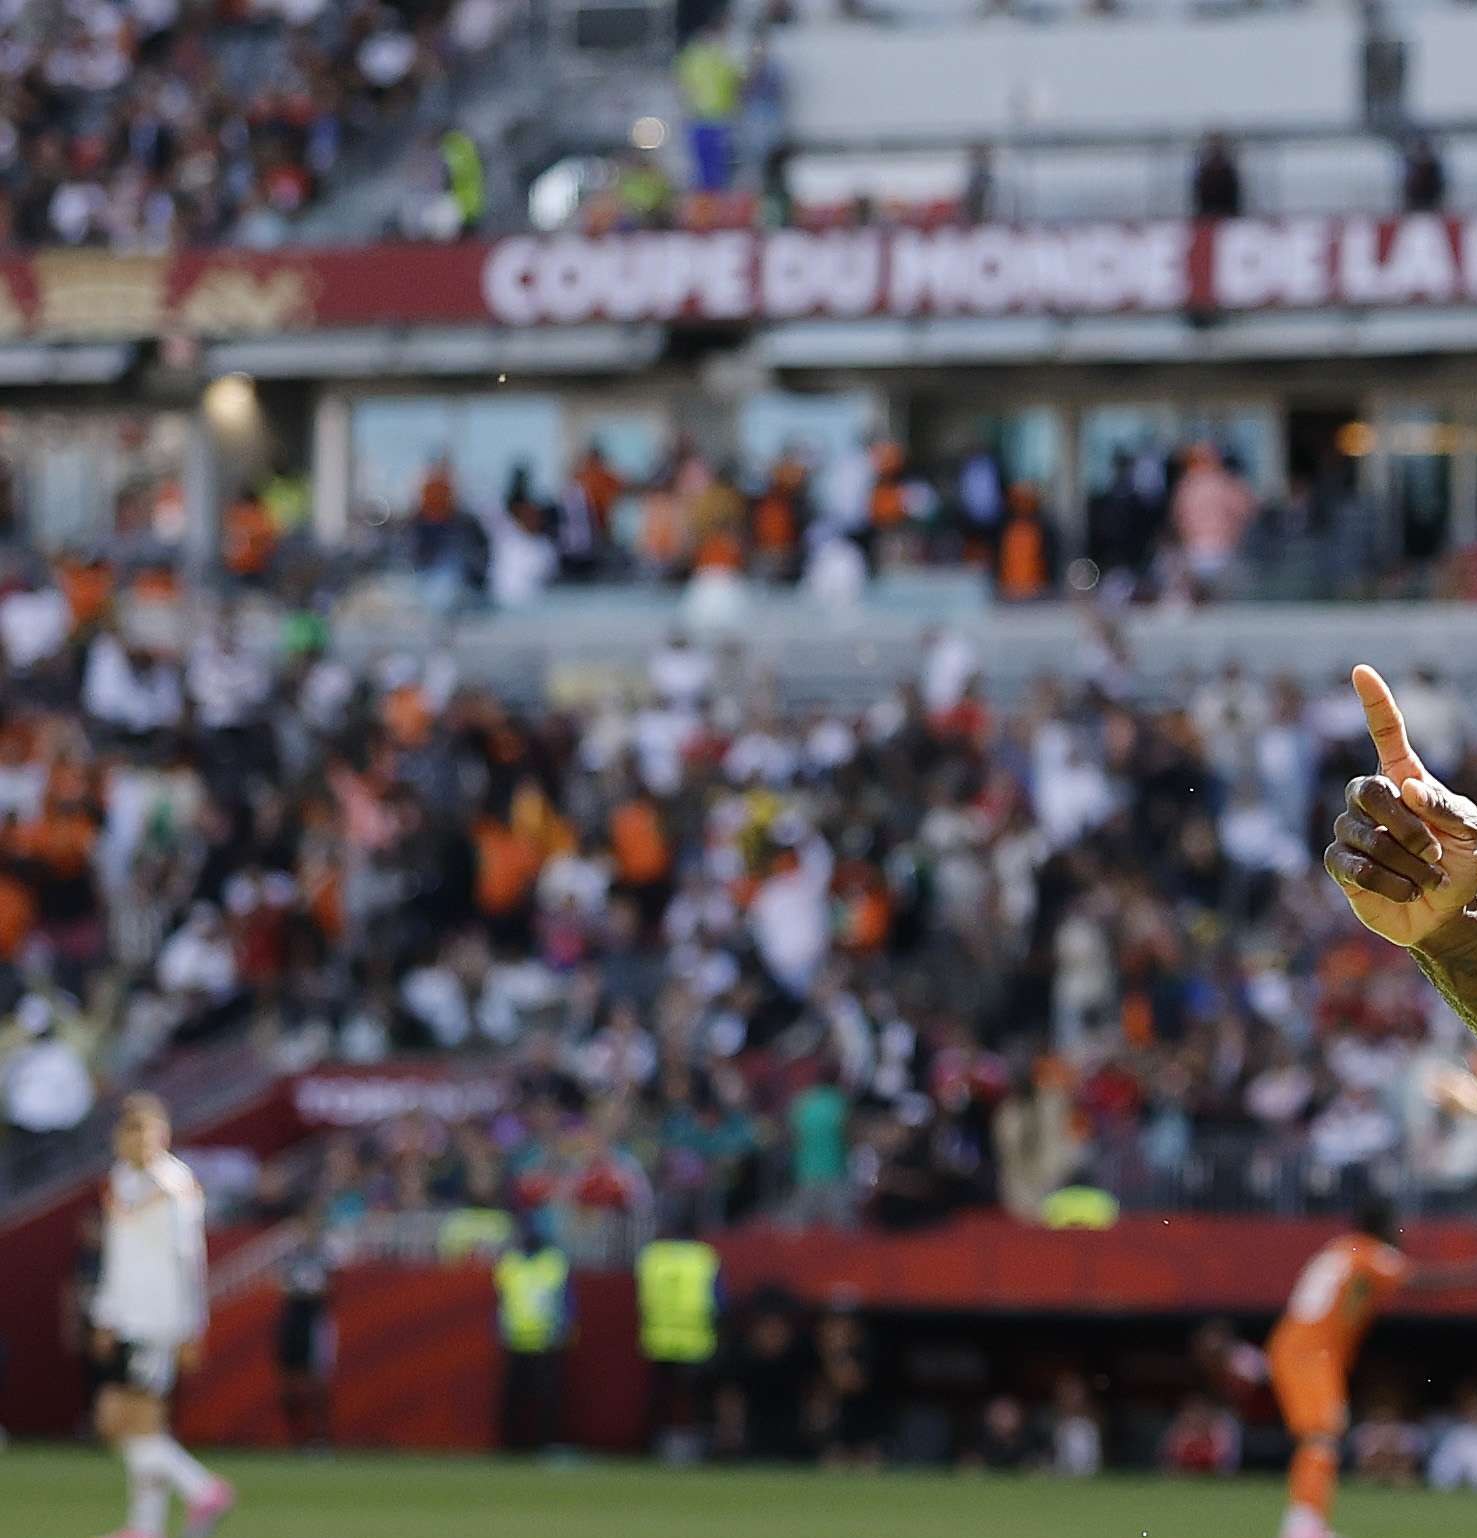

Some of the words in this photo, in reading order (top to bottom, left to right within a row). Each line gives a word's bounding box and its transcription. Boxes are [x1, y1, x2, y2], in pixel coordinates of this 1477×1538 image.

[484, 229, 751, 325] COUPE
[762, 227, 880, 320] DU
[890, 219, 1190, 313] MONDE
[1213, 213, 1330, 308] DE
[1340, 208, 1458, 303] LA
